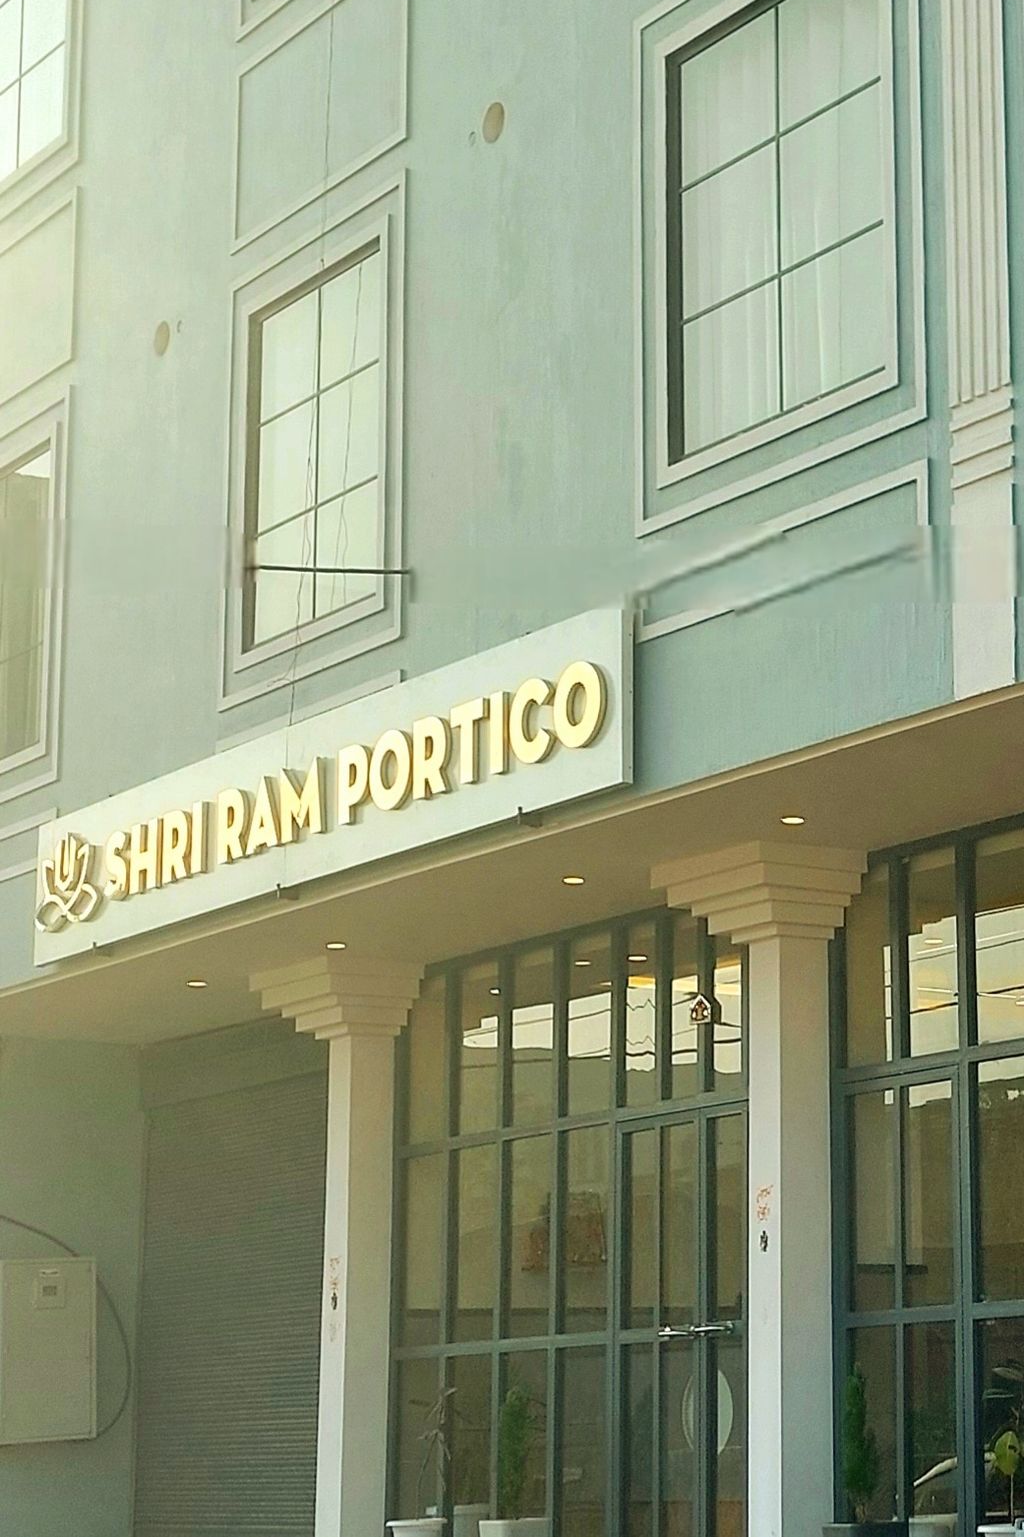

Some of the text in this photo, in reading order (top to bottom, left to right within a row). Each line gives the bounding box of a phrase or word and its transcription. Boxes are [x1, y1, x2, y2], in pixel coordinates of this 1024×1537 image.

[105, 661, 607, 899] SHRI RAM PORTICO
